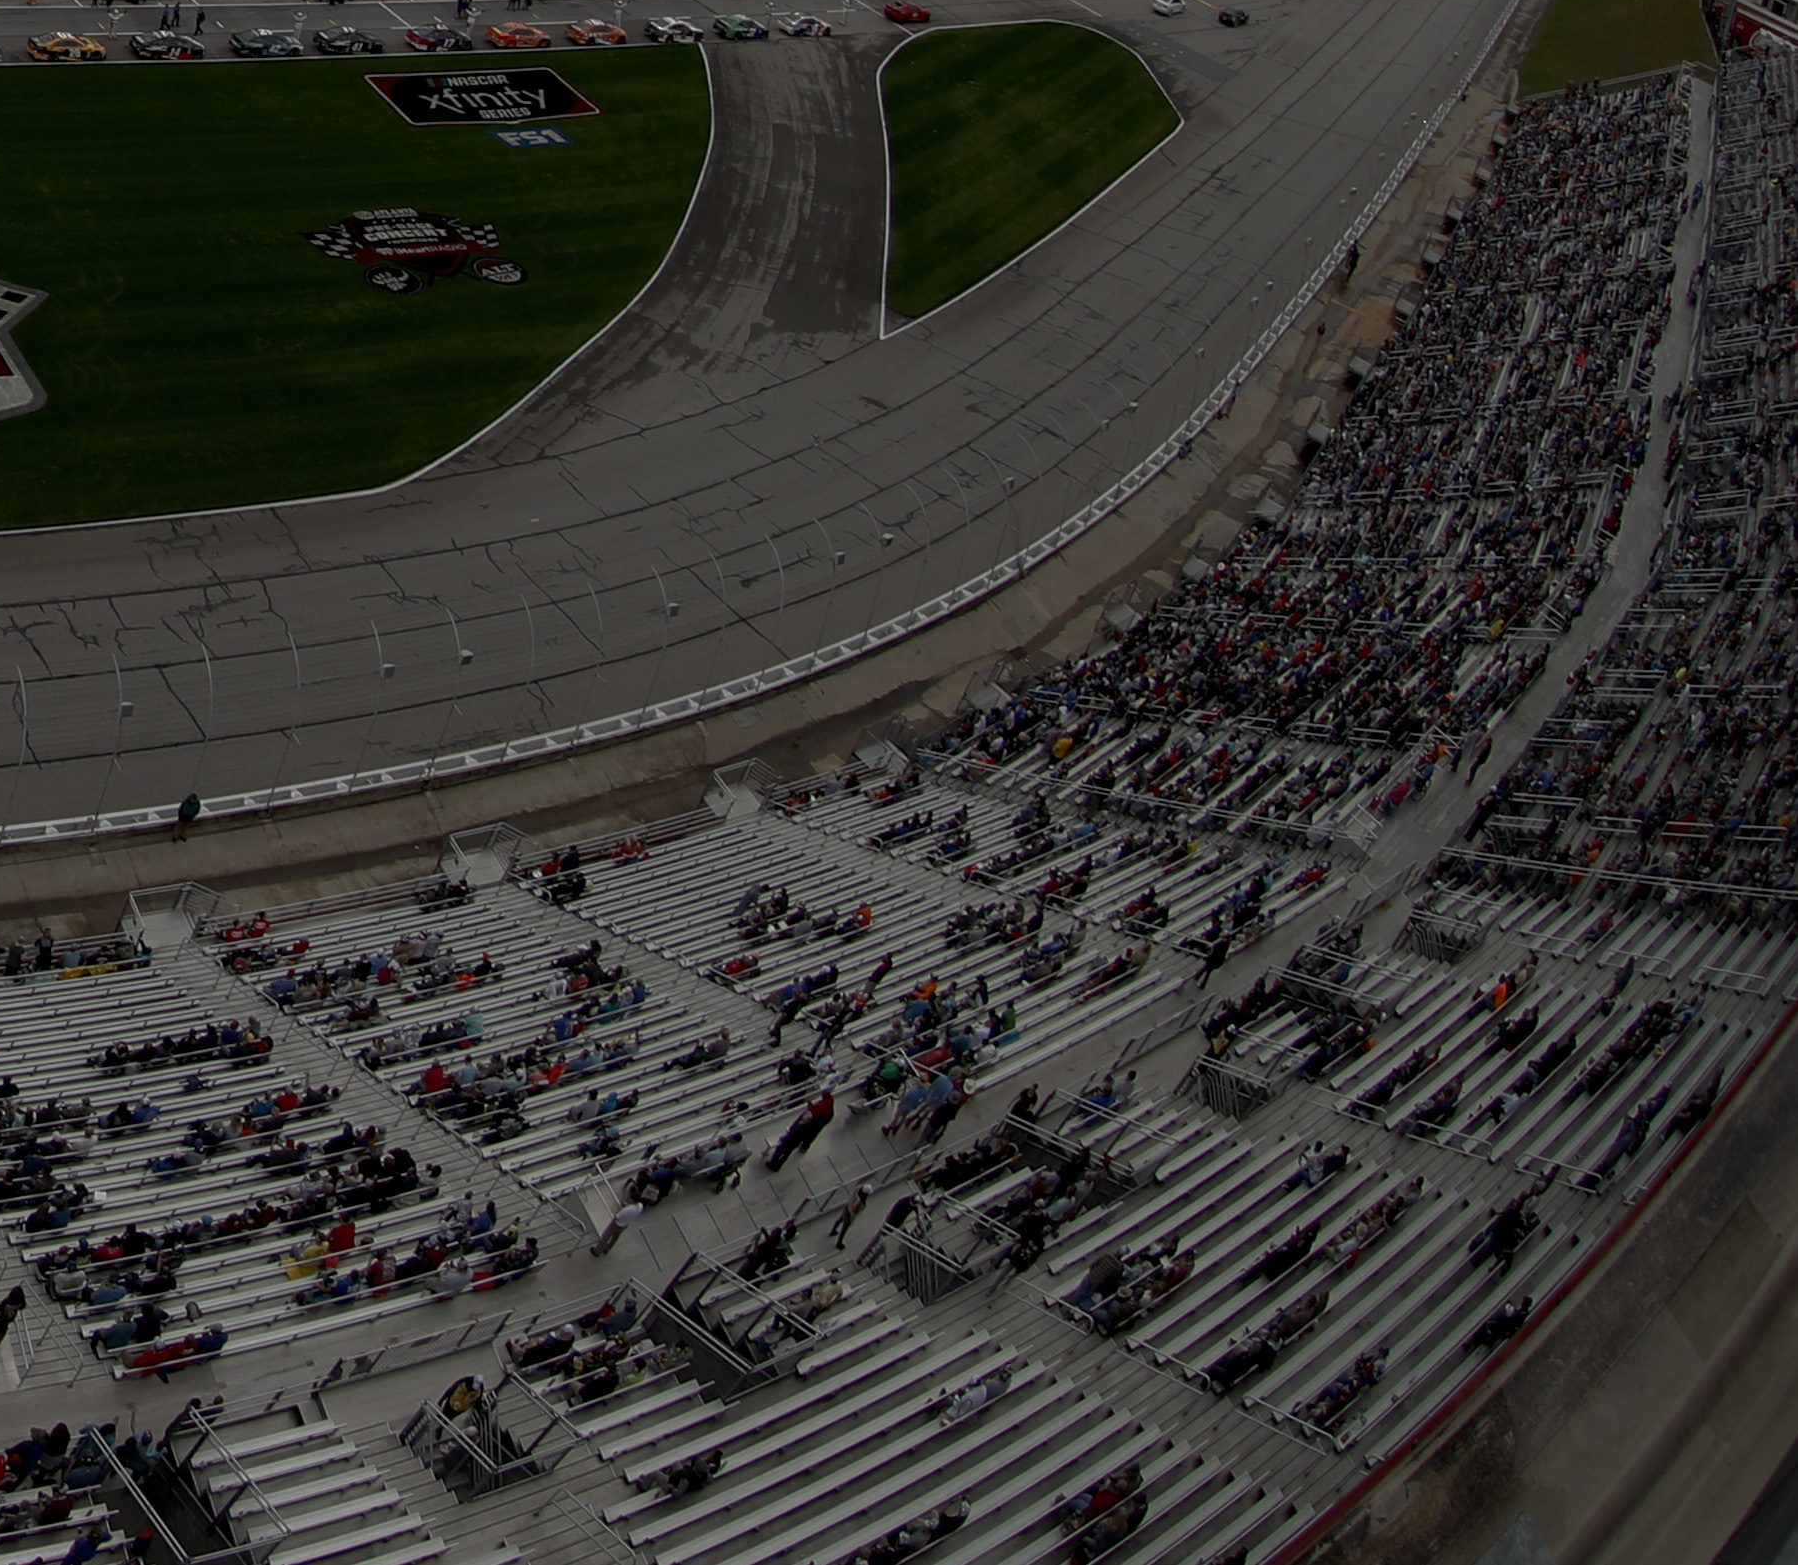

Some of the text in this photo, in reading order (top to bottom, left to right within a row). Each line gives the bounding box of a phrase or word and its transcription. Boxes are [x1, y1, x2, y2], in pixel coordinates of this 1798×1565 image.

[444, 38, 456, 47] 17
[447, 74, 508, 87] NASCAR
[418, 85, 546, 115] xfinity
[478, 107, 532, 121] SERIES
[495, 127, 567, 147] FS1
